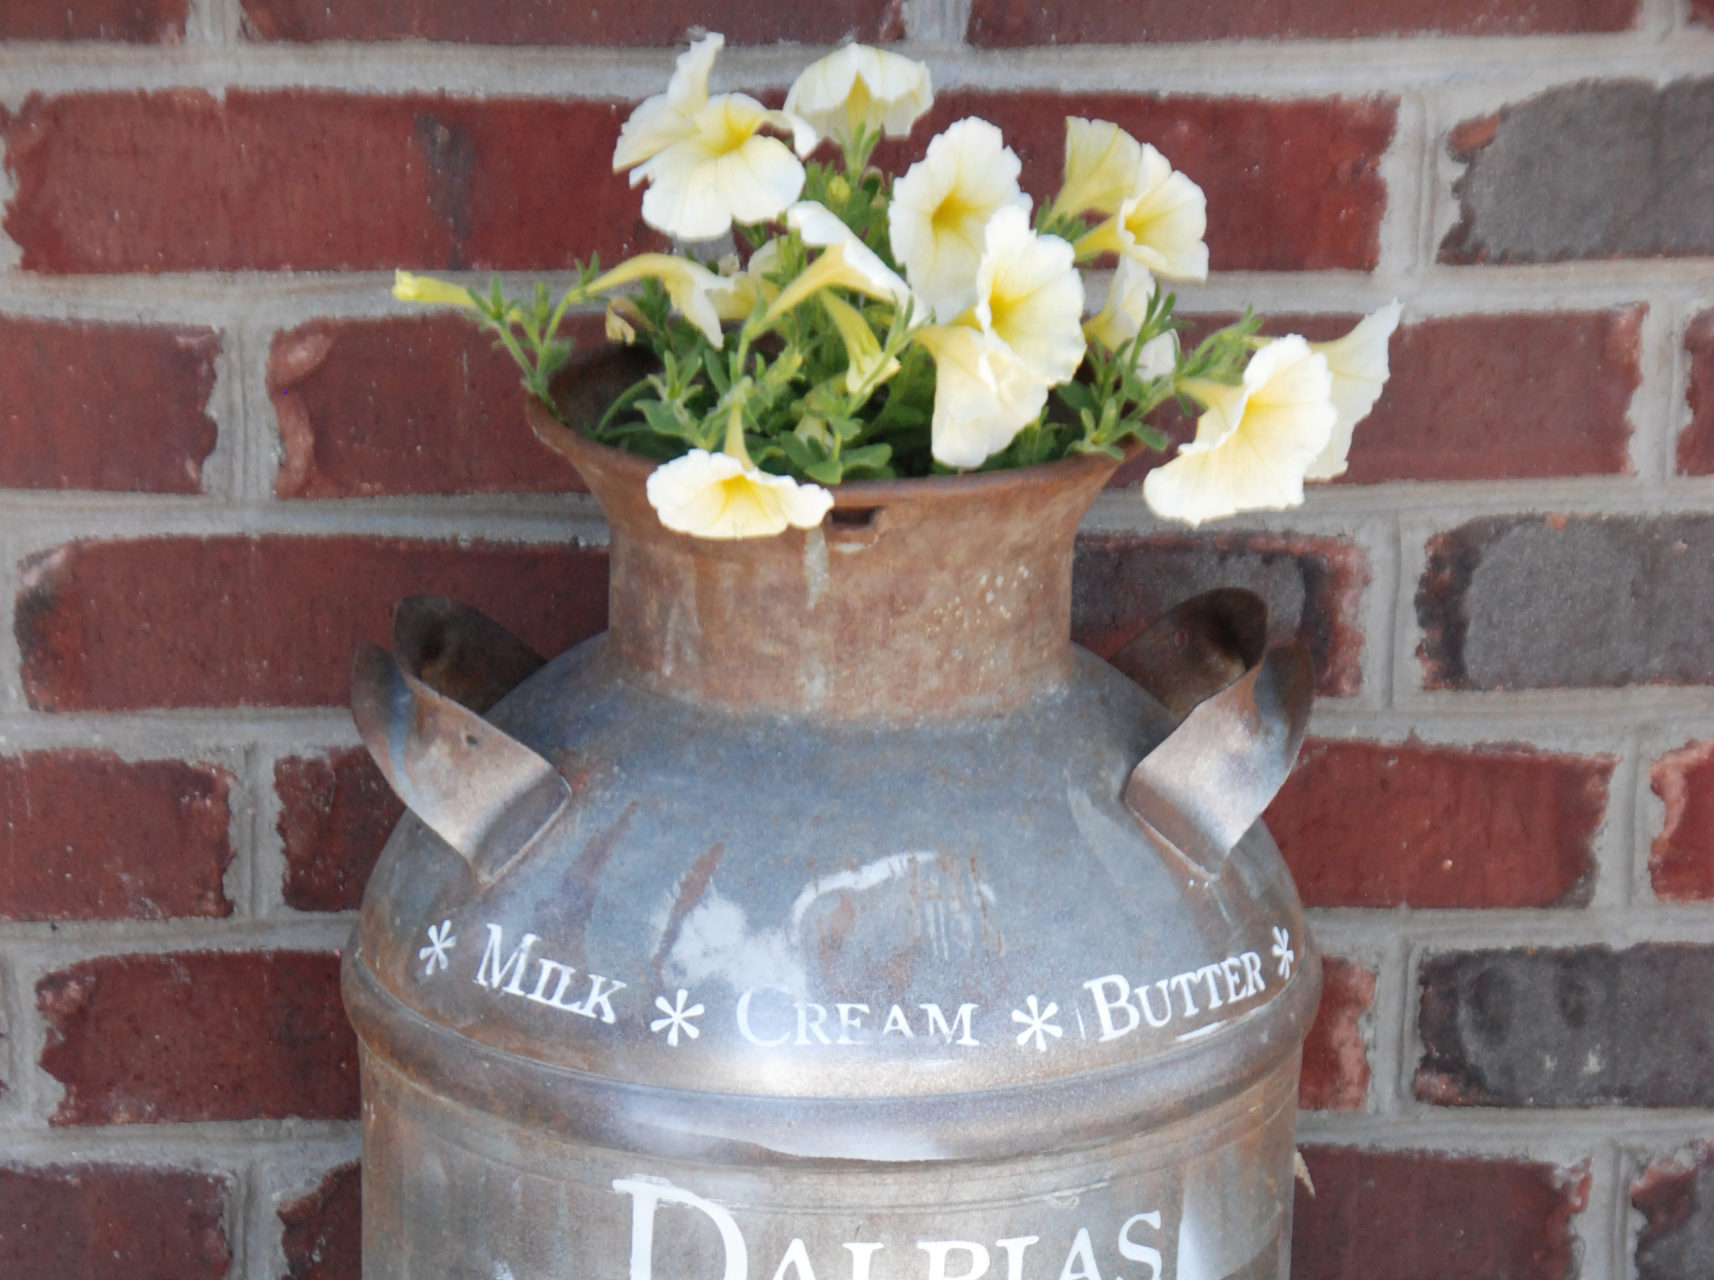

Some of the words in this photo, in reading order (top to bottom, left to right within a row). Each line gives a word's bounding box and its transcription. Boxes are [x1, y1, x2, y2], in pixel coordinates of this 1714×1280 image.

[472, 922, 627, 1025] MILK
[736, 984, 980, 1047] CREAM
[1083, 950, 1267, 1043] BUTTER
